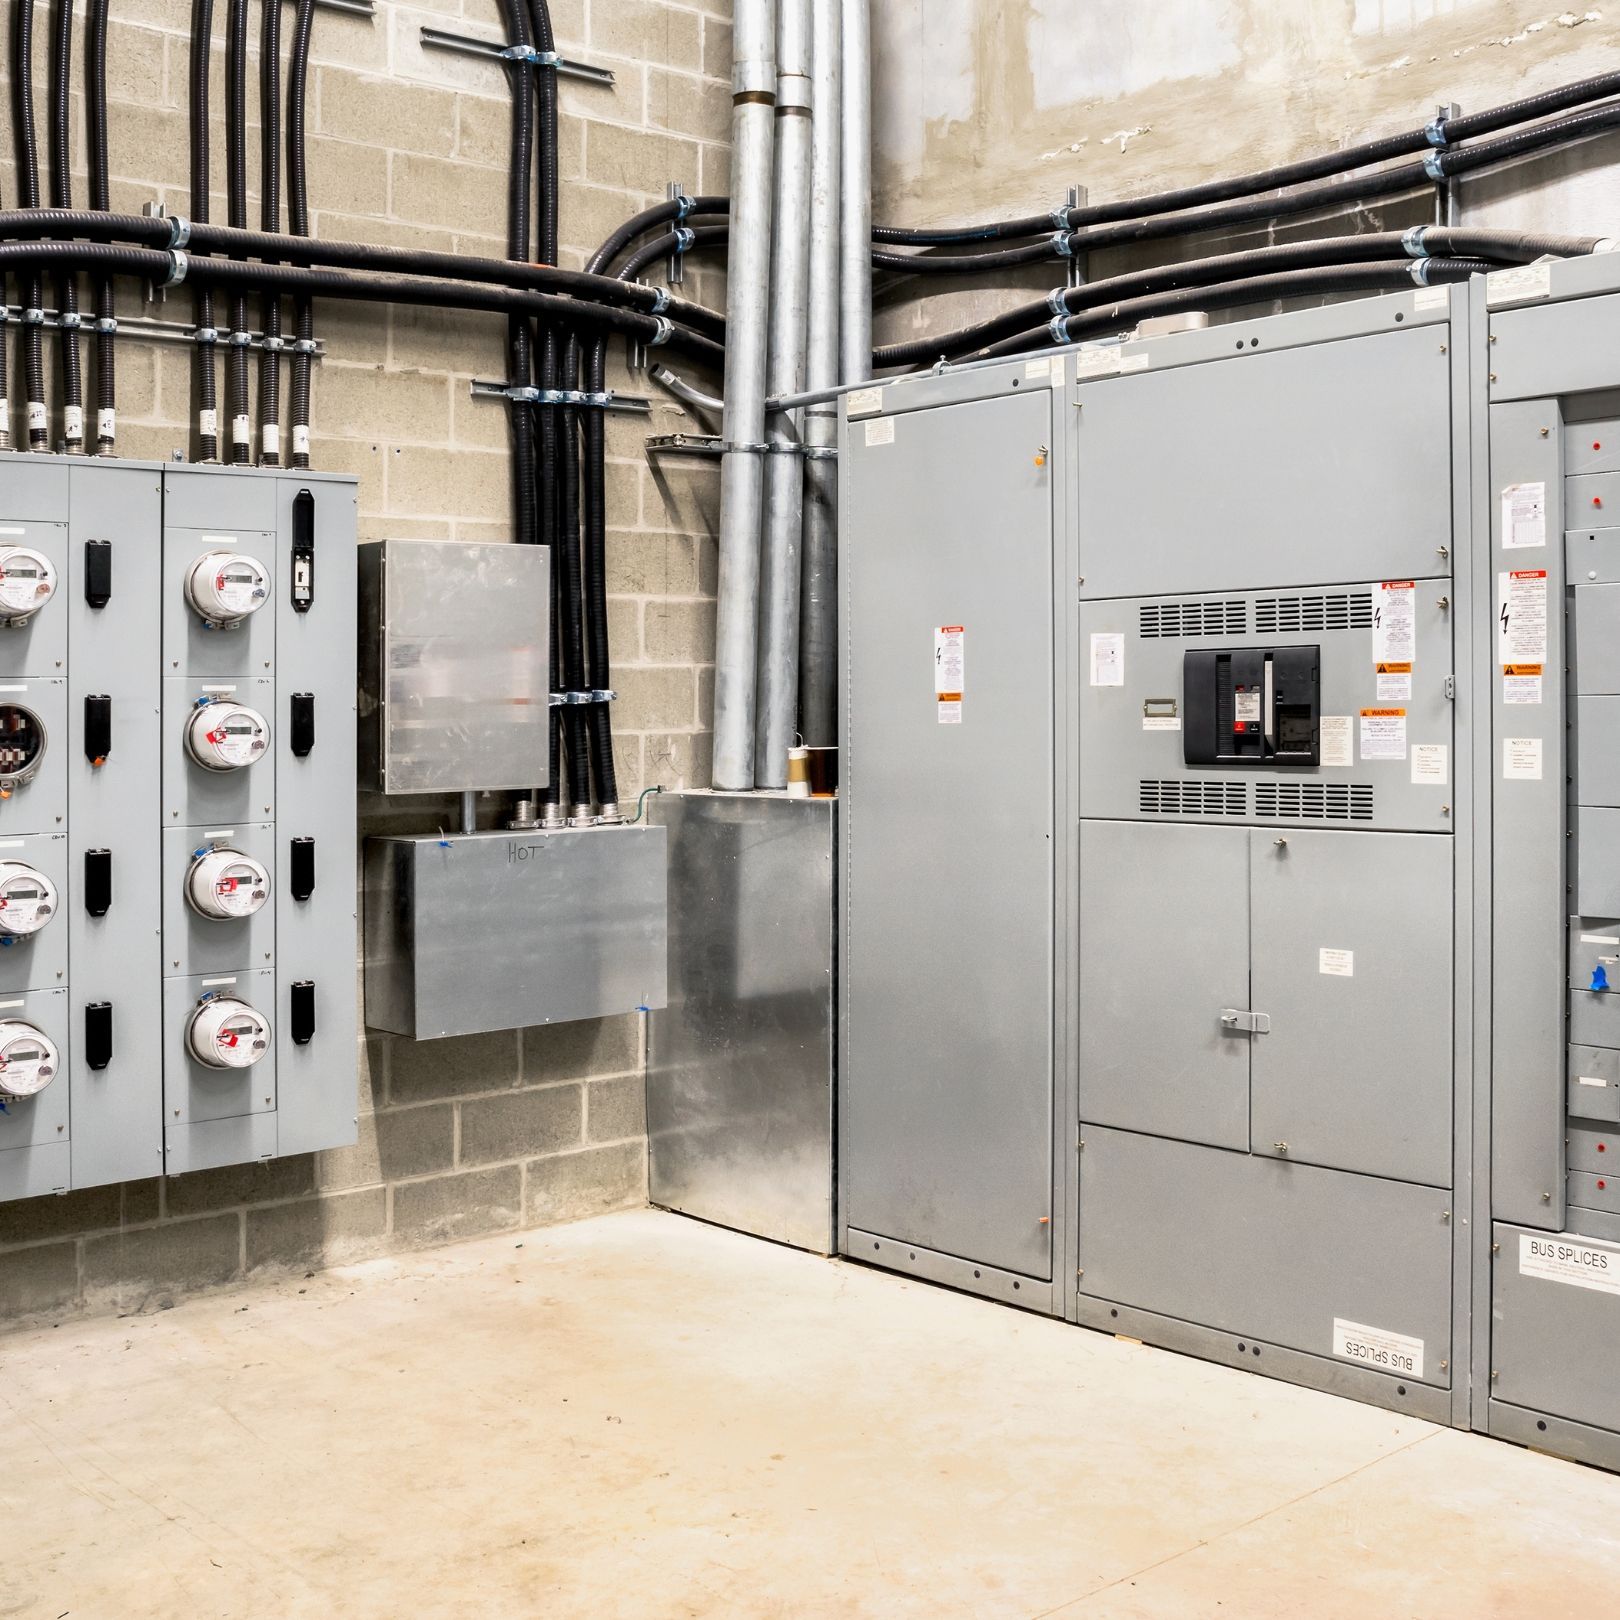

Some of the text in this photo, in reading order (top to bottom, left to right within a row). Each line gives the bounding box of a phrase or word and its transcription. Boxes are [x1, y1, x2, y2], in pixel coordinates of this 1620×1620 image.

[508, 842, 545, 863] HOT
[1531, 1241, 1608, 1269] BUS SPLICES
[1346, 1341, 1413, 1371] BUS SPLICES
